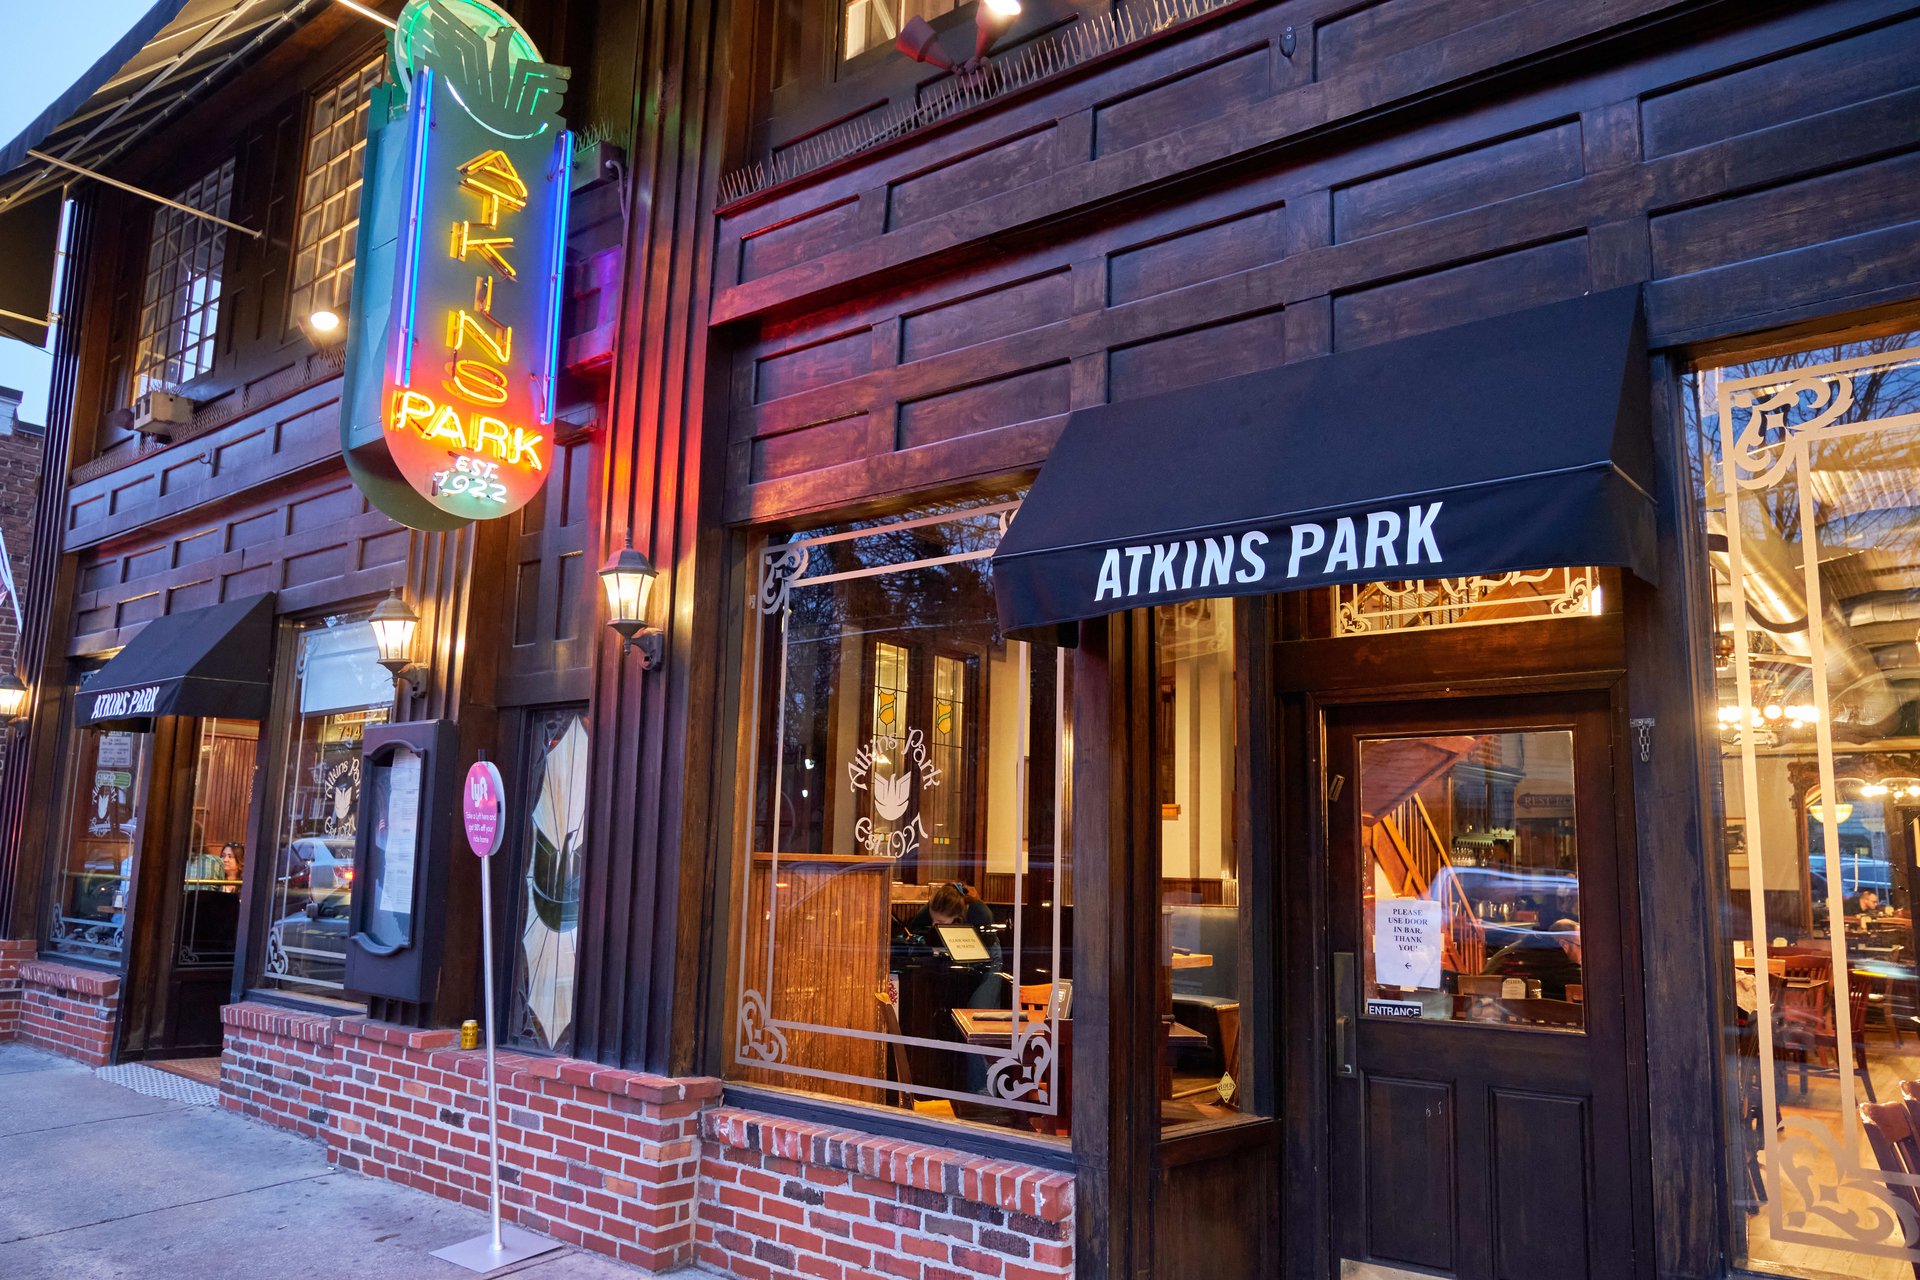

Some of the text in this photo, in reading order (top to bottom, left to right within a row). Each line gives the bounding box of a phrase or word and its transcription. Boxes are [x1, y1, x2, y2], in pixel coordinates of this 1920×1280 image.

[452, 150, 527, 406] ATKINS
[391, 390, 543, 471] PARK
[434, 471, 508, 503] 1922
[1094, 501, 1444, 602] ATKINS PARK
[91, 686, 160, 719] ATKINS PARK
[848, 726, 943, 793] Atkins Park
[1524, 795, 1552, 807] REST
[886, 812, 928, 858] 1927
[1388, 917, 1428, 926] USE DOOR
[1393, 908, 1423, 916] PLEASE
[1394, 935, 1423, 943] THANK
[1398, 944, 1419, 952] YOU!
[1368, 1005, 1420, 1017] ENTRANCE
